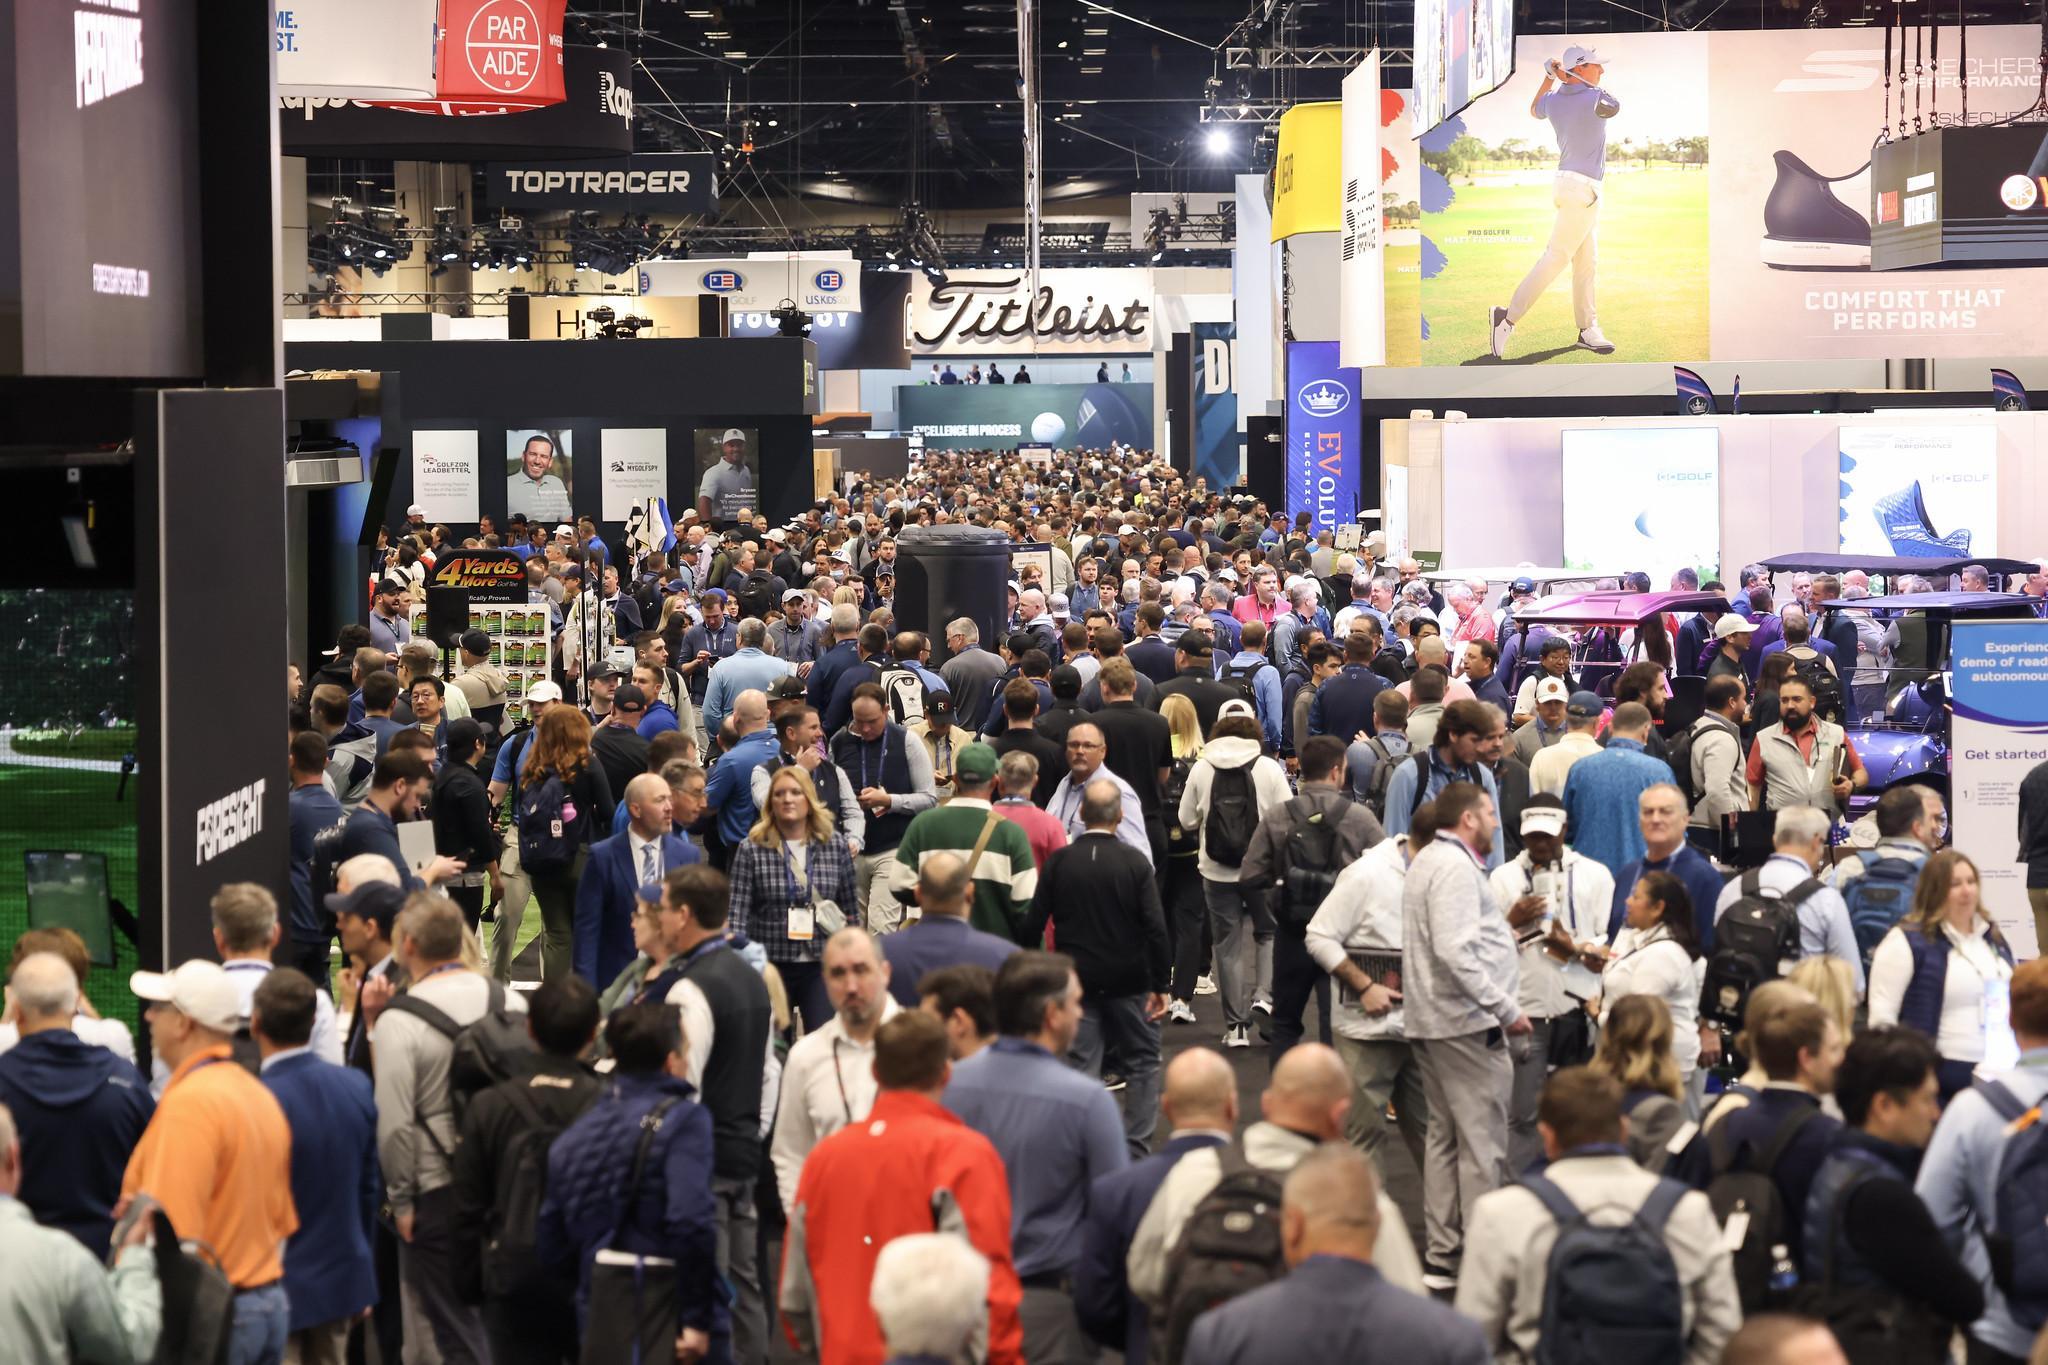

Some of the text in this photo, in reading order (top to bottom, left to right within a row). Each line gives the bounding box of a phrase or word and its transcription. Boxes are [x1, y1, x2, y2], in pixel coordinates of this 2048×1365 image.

[487, 15, 527, 42] PAR
[482, 50, 529, 76] AIDE
[599, 71, 633, 130] Rap
[505, 170, 690, 194] TOPTRACER
[913, 276, 1149, 345] Titleist
[1804, 288, 2006, 310] COMFORT THAT
[1833, 310, 1977, 330] PERFORMS
[913, 423, 1022, 437] EXCELLENCE IN PROCESS
[1303, 432, 1311, 505] ELECTRIC
[435, 558, 519, 587] 4 Yards
[459, 575, 498, 588] More
[1959, 657, 1997, 668] demo
[2000, 656, 2015, 668] of
[1965, 749, 2047, 760] Get started
[196, 778, 266, 867] FORESIGHT
